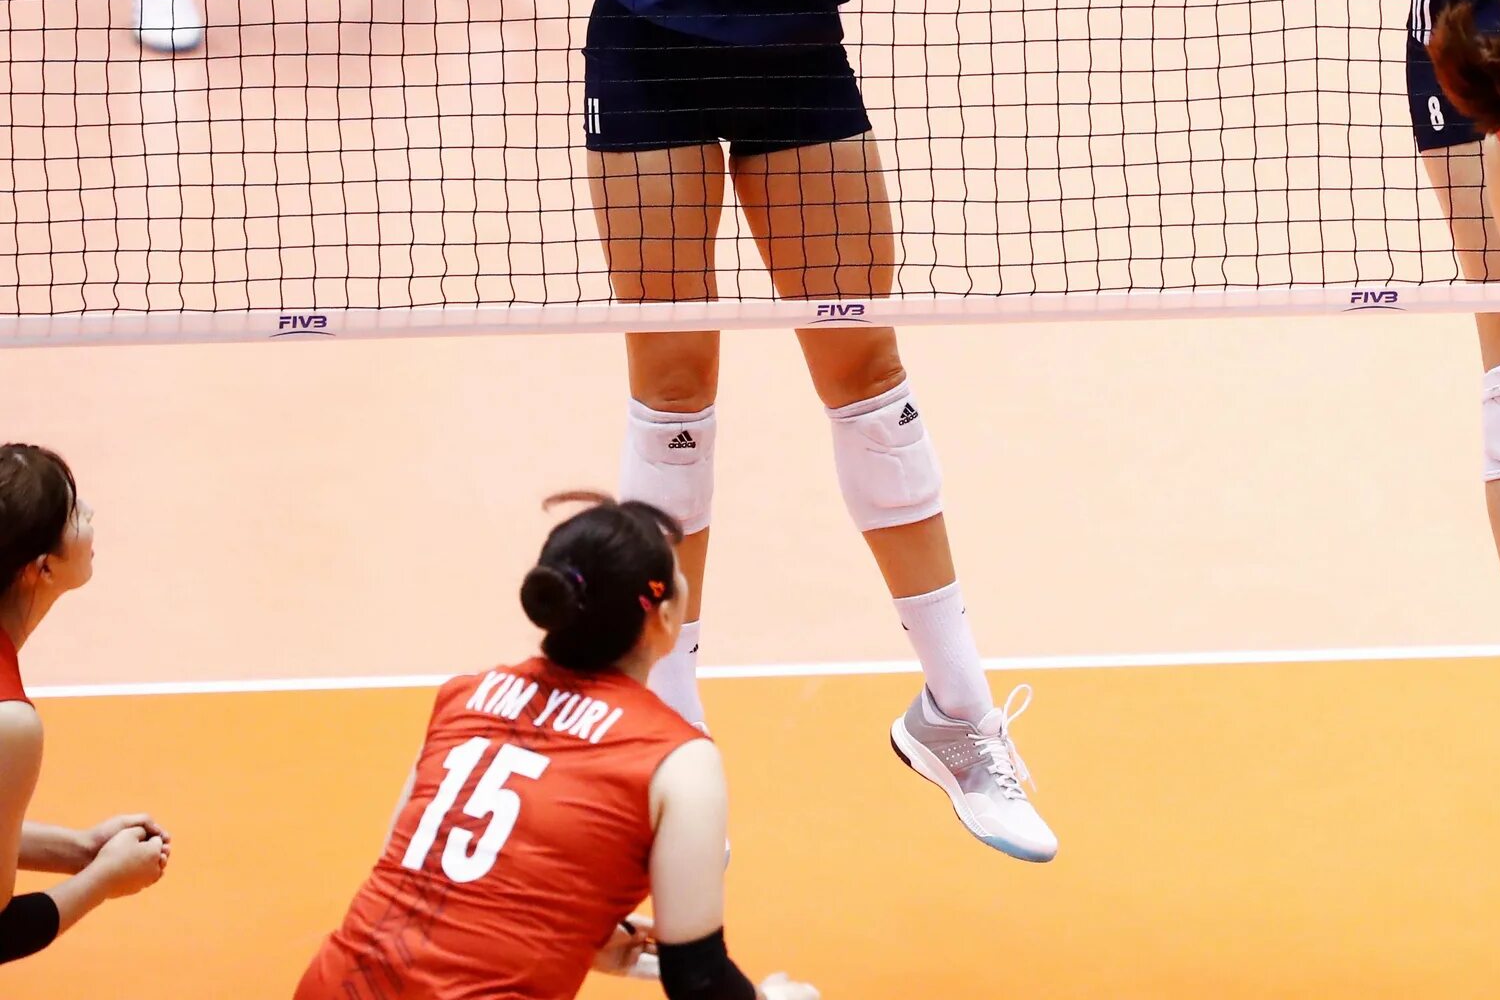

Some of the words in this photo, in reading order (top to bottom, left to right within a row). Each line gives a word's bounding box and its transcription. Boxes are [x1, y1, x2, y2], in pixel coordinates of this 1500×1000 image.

[1428, 96, 1445, 131] 8
[1351, 291, 1398, 303] FIVB
[279, 316, 327, 329] FIVB
[817, 305, 865, 317] FIVB
[466, 671, 536, 720] KIM
[532, 687, 623, 744] YURI
[401, 736, 551, 883] 15
